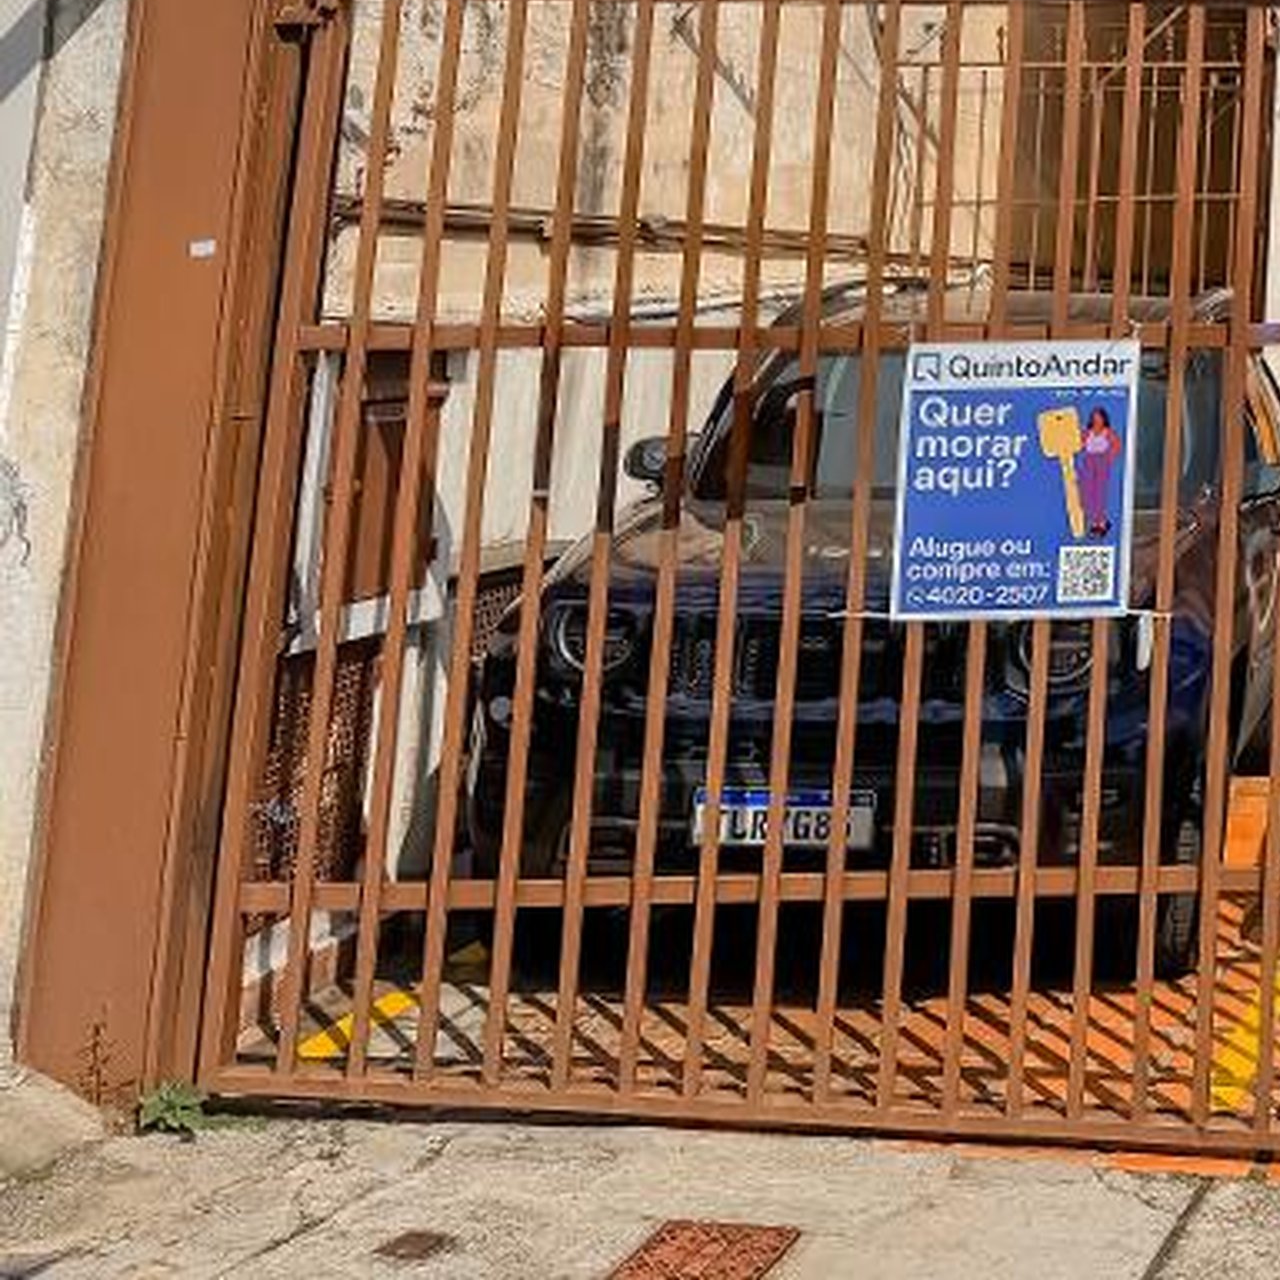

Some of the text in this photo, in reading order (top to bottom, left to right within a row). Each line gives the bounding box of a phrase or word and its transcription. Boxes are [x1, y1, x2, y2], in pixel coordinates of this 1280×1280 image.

[949, 354, 1132, 380] QuintoAndar
[919, 395, 1013, 428] Quer
[916, 434, 1028, 458] morar
[914, 458, 1018, 496] aqui?
[908, 536, 1031, 561] Alugue ou
[906, 561, 1001, 583] compre
[709, 808, 851, 841] LRG8
